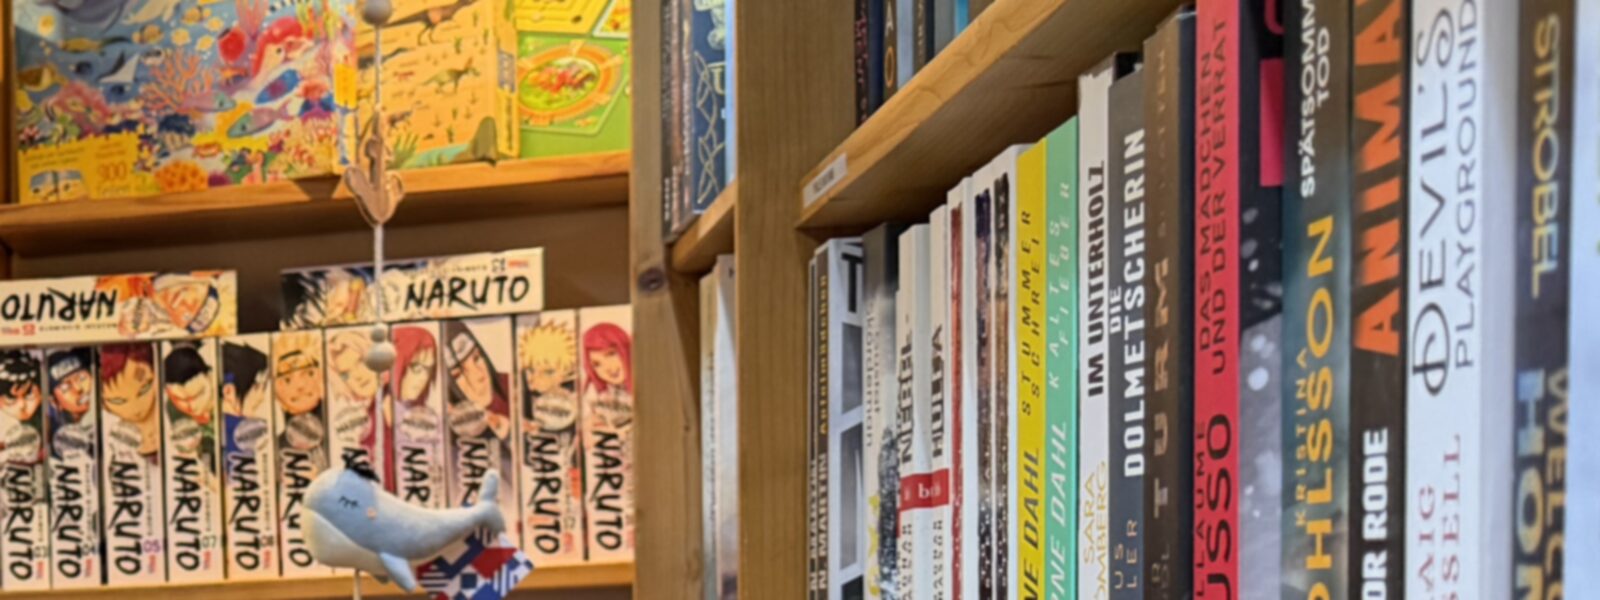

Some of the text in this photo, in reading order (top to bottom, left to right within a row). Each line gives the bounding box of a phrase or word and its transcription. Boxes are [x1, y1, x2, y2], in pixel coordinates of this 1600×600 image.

[1316, 27, 1331, 108] TOD
[1211, 20, 1226, 376] UND DER VERRAT
[1354, 0, 1401, 356] ANIMA
[1532, 13, 1560, 299] STROBEL
[1, 288, 118, 322] NARUTO
[404, 275, 530, 312] NARUTO
[1087, 160, 1104, 397] IM UNTERHOLZ
[1109, 285, 1122, 334] DIE
[1124, 128, 1145, 477] DOLMETSCHERIN
[1201, 271, 1212, 350] DAS
[591, 430, 624, 551] NARUTO
[1050, 421, 1067, 527] DAHL
[1294, 348, 1308, 526] KRISTINA
[1363, 428, 1389, 540] RODE
[5, 466, 34, 580] NARUTO
[52, 464, 83, 578] NARUTO
[107, 461, 143, 574] NARUTO
[170, 456, 201, 571] NARUTO
[229, 454, 261, 571] NARUTO
[528, 435, 562, 555] NARUTO
[1024, 448, 1040, 550] DAHL
[1083, 473, 1096, 564] SARA
[1418, 485, 1435, 600] AIG
